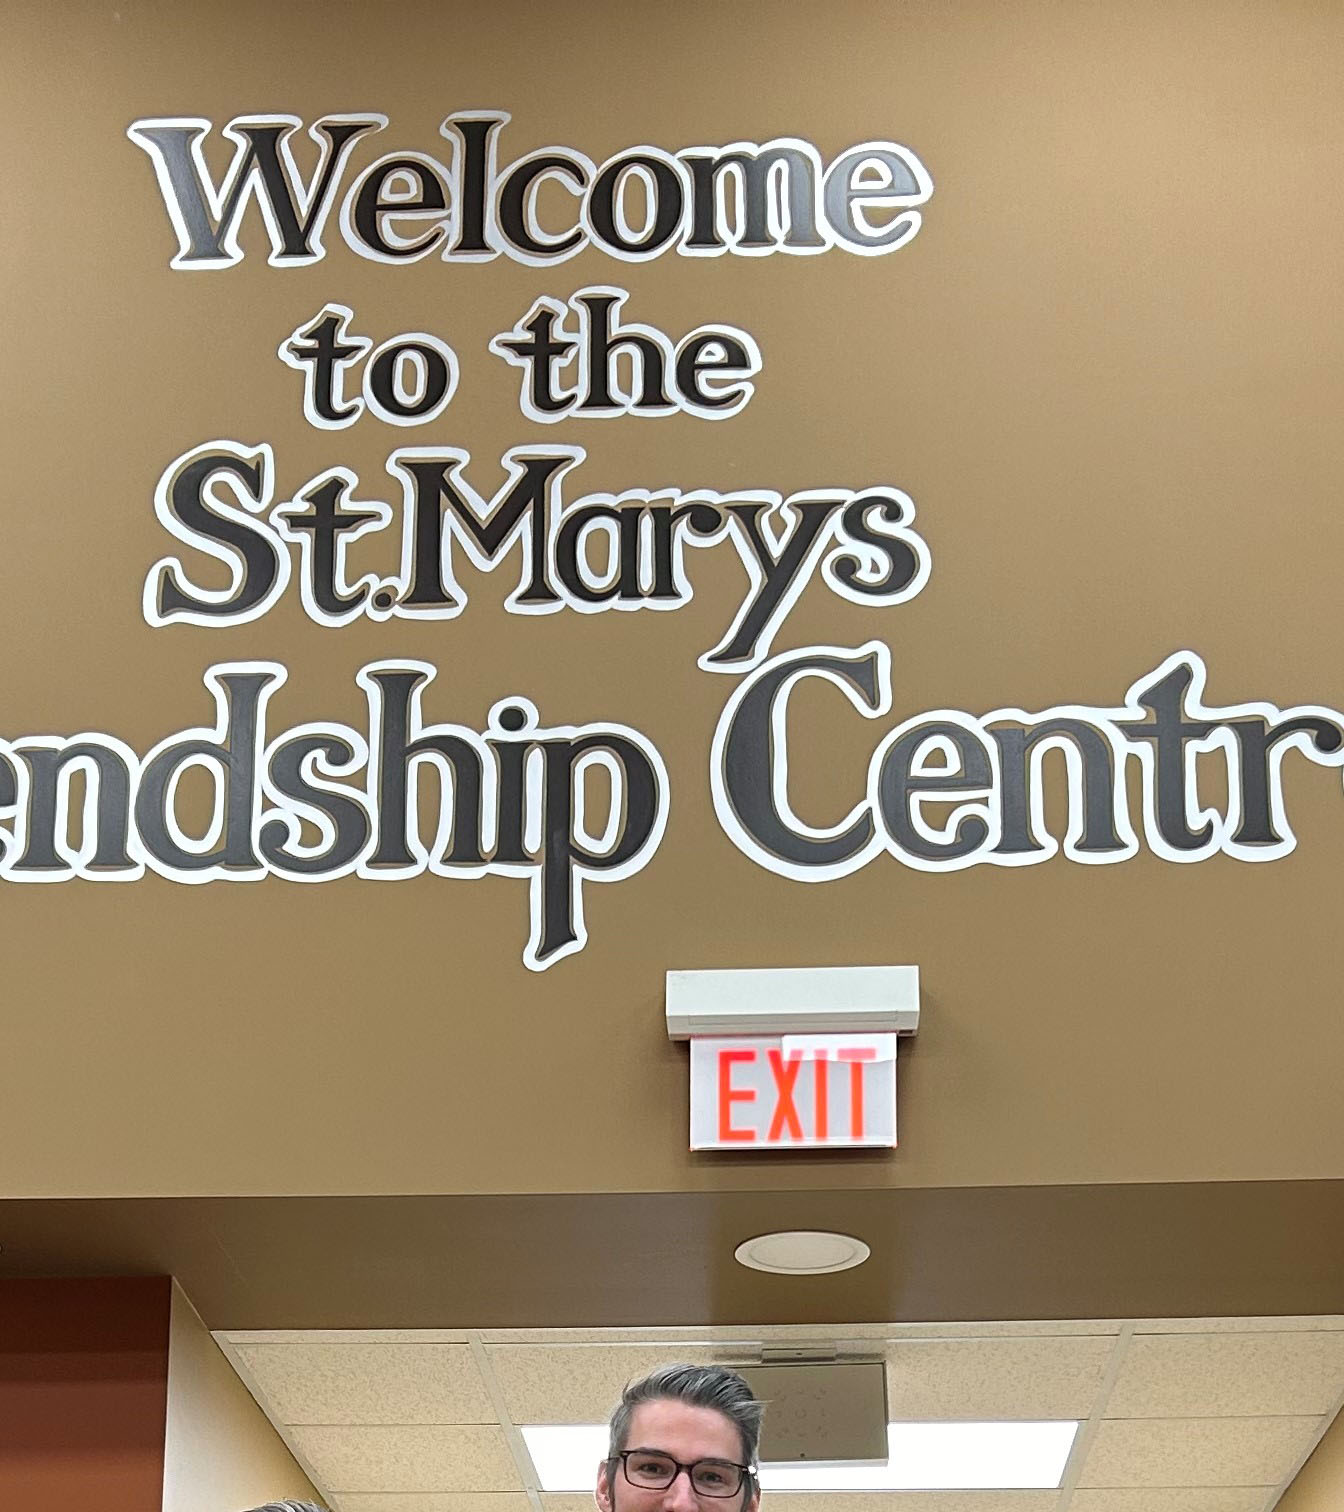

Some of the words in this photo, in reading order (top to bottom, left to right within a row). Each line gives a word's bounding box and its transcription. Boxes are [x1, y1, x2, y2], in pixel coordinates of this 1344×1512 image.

[129, 112, 933, 267] Welcome
[280, 305, 458, 428] to
[490, 287, 762, 421] the
[717, 1047, 877, 1143] EXIT
